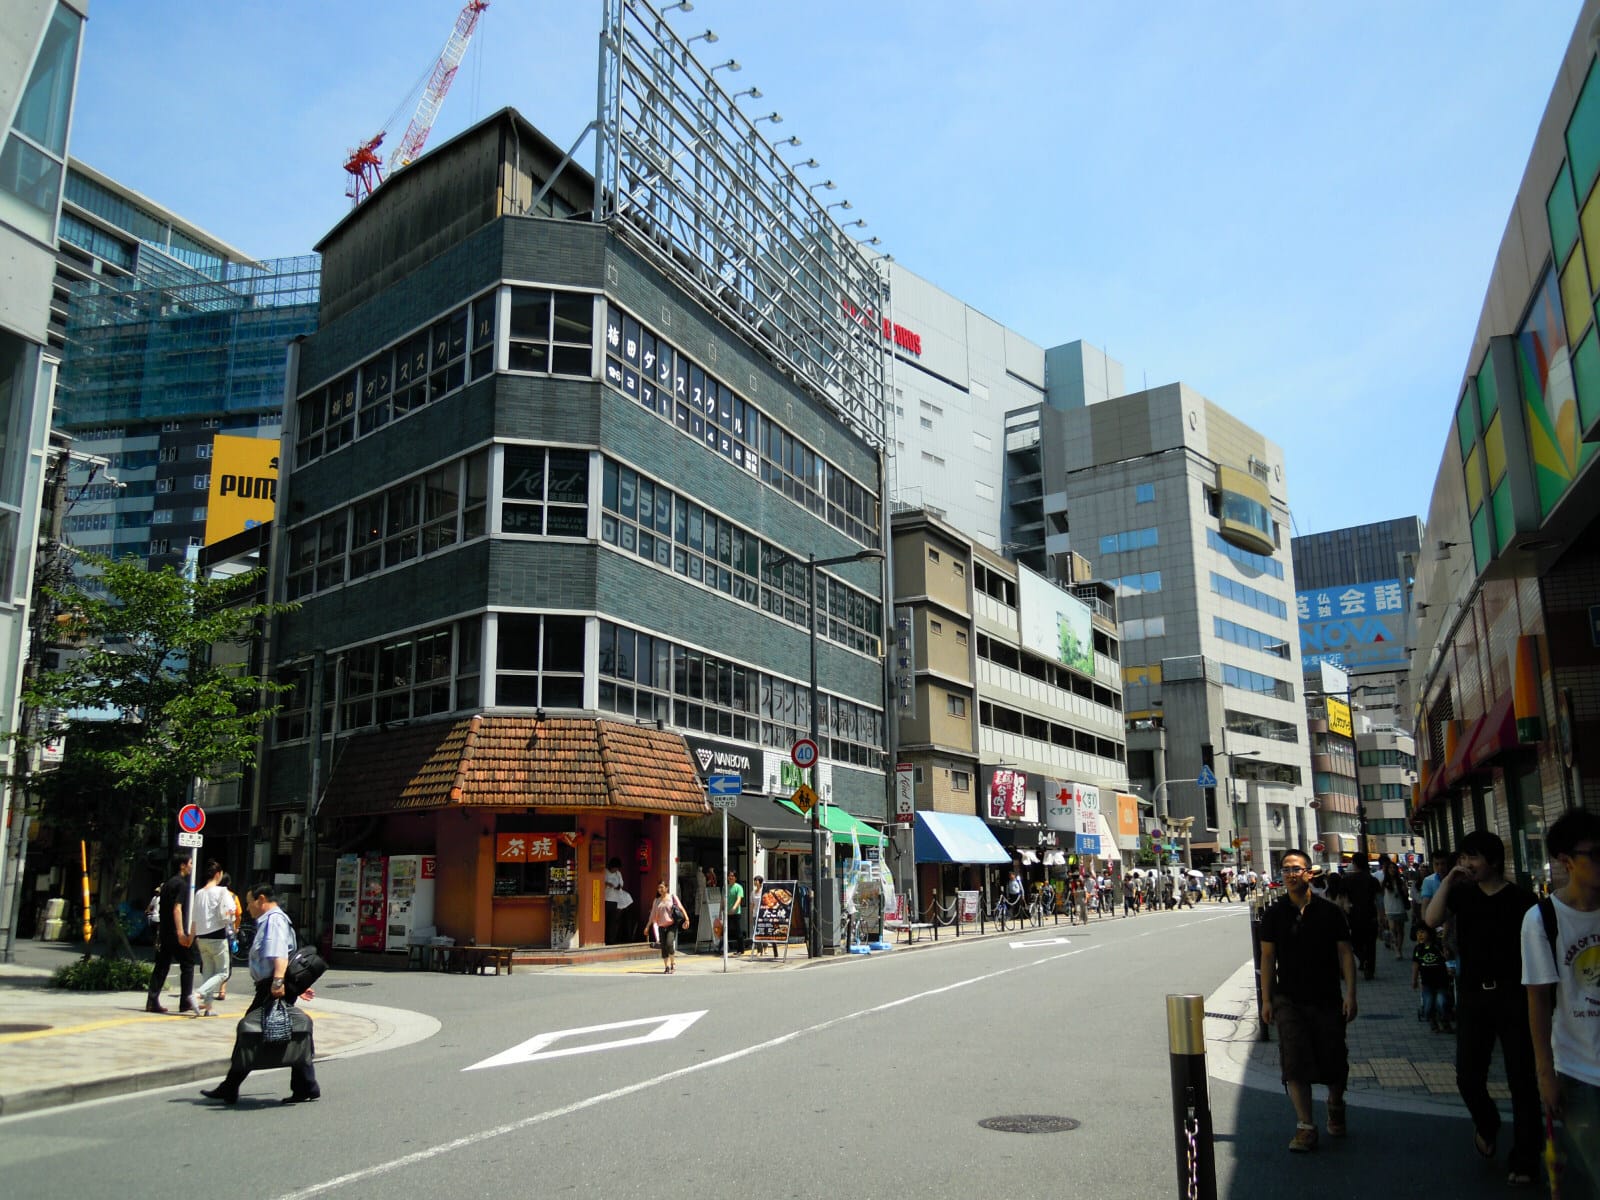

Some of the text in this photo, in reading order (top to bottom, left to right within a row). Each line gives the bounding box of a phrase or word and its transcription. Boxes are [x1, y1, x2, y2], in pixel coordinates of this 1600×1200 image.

[608, 324, 742, 434] 梅田ダンススクール
[220, 475, 277, 502] PUM
[1300, 617, 1396, 651] NOVA
[714, 752, 750, 770] NANBOYA
[797, 747, 812, 760] 40
[1082, 792, 1097, 809] くすり
[1049, 807, 1072, 816] くすり
